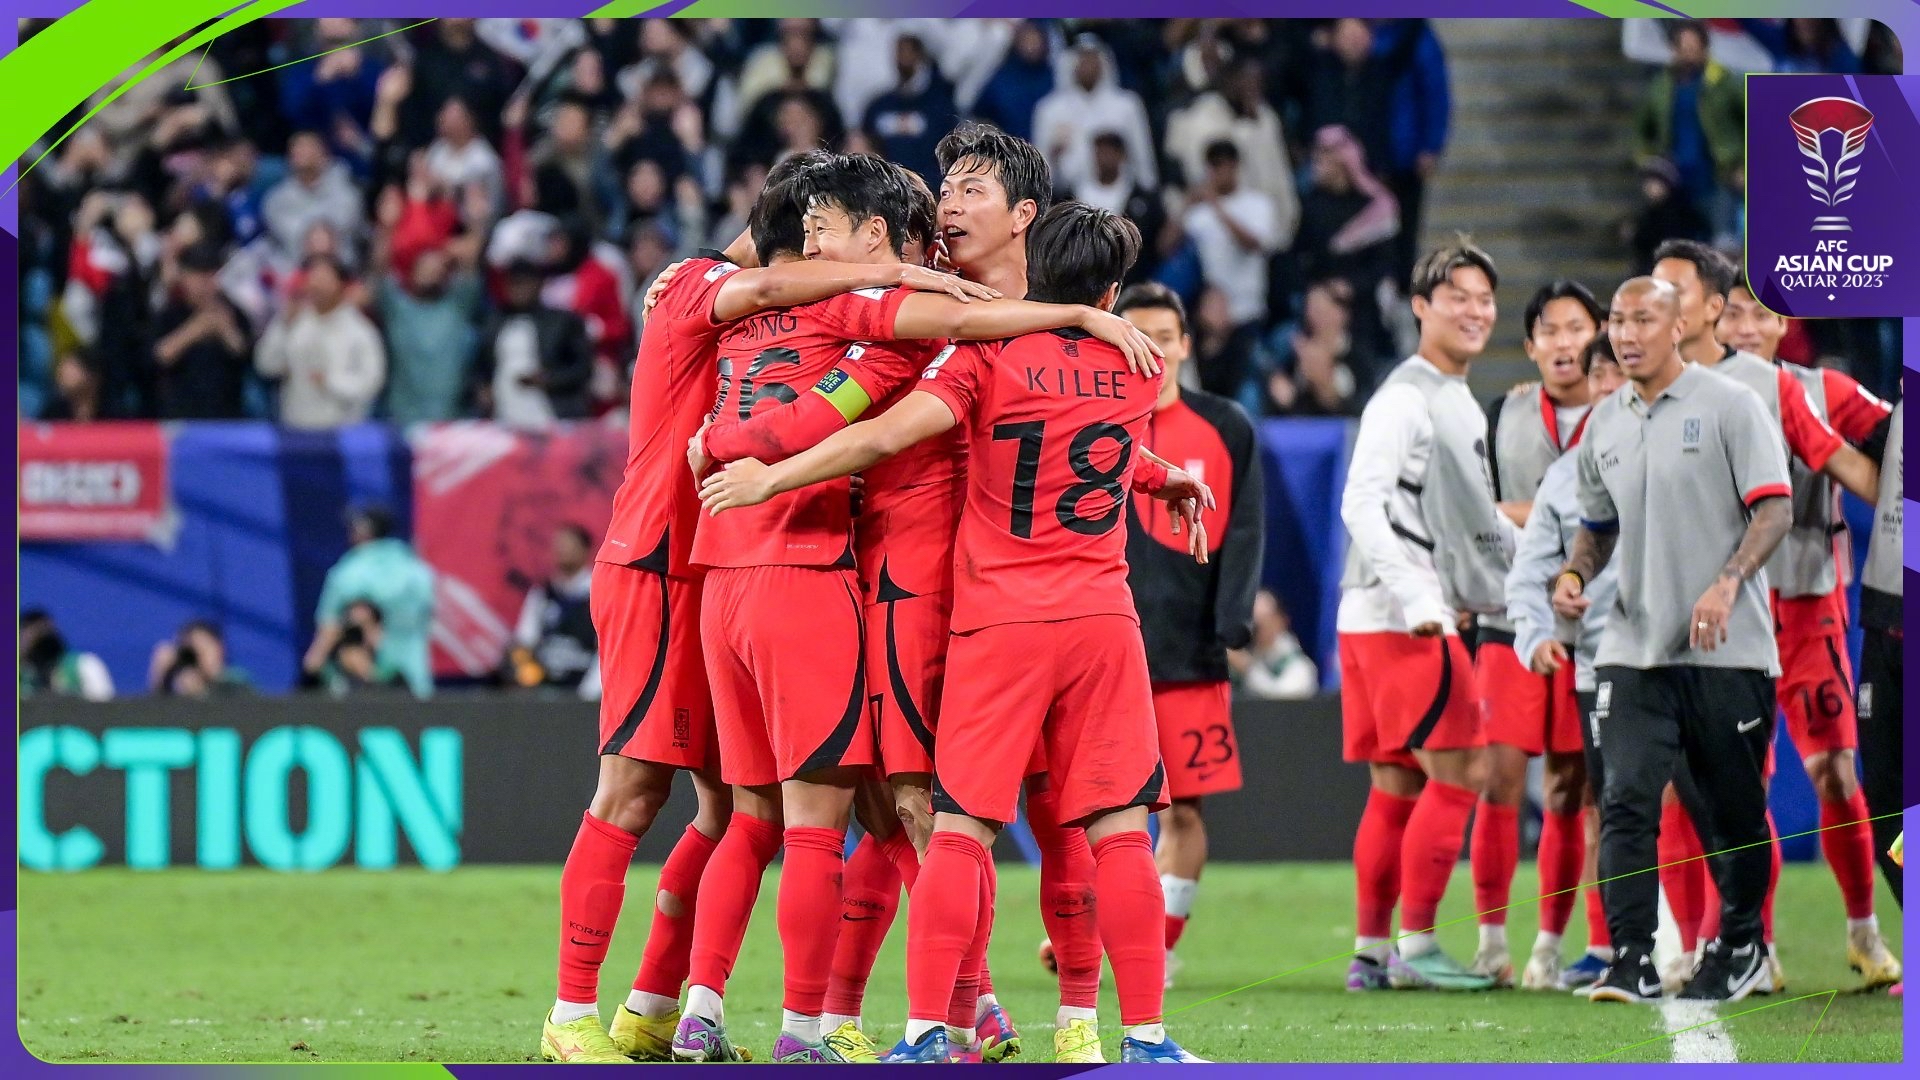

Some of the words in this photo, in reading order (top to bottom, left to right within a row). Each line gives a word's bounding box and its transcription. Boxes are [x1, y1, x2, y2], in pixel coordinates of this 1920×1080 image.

[992, 419, 1132, 540] 18
[1801, 678, 1843, 723] 16
[1181, 724, 1233, 769] 23
[18, 725, 464, 872] CTION
[569, 921, 610, 938] KOREA
